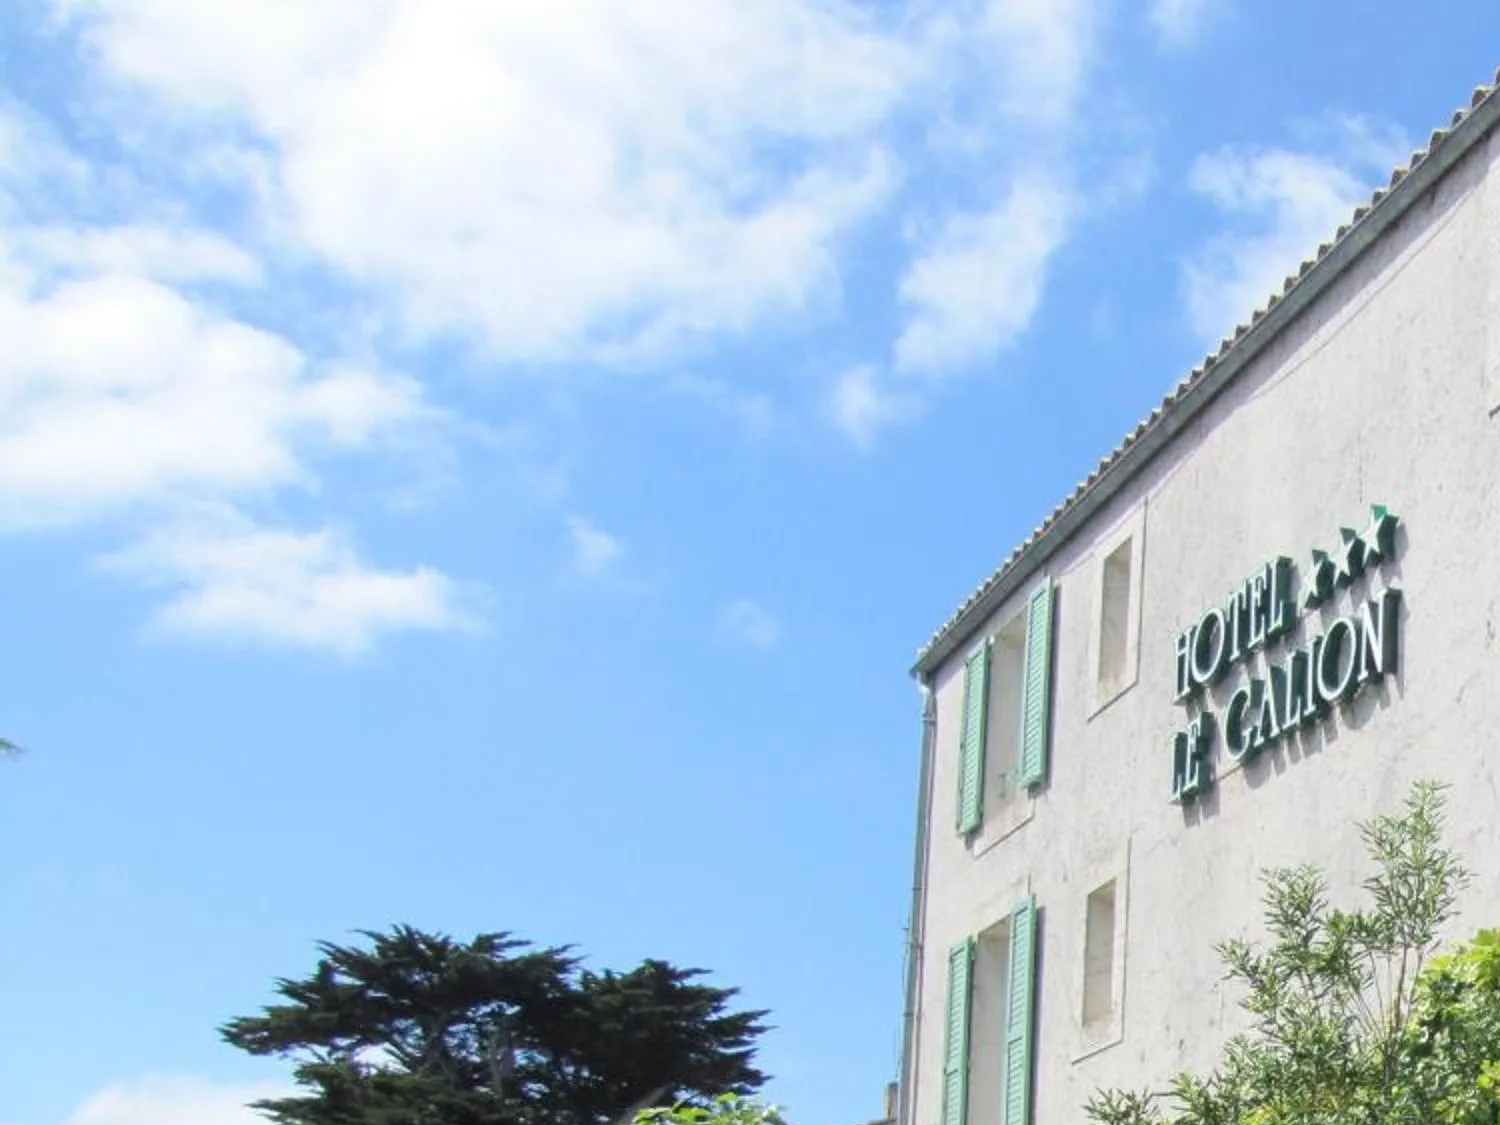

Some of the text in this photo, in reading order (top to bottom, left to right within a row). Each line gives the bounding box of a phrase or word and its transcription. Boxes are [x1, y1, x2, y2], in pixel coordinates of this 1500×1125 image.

[1168, 585, 1403, 804] LE GALION
[1172, 555, 1295, 705] HOTEL
